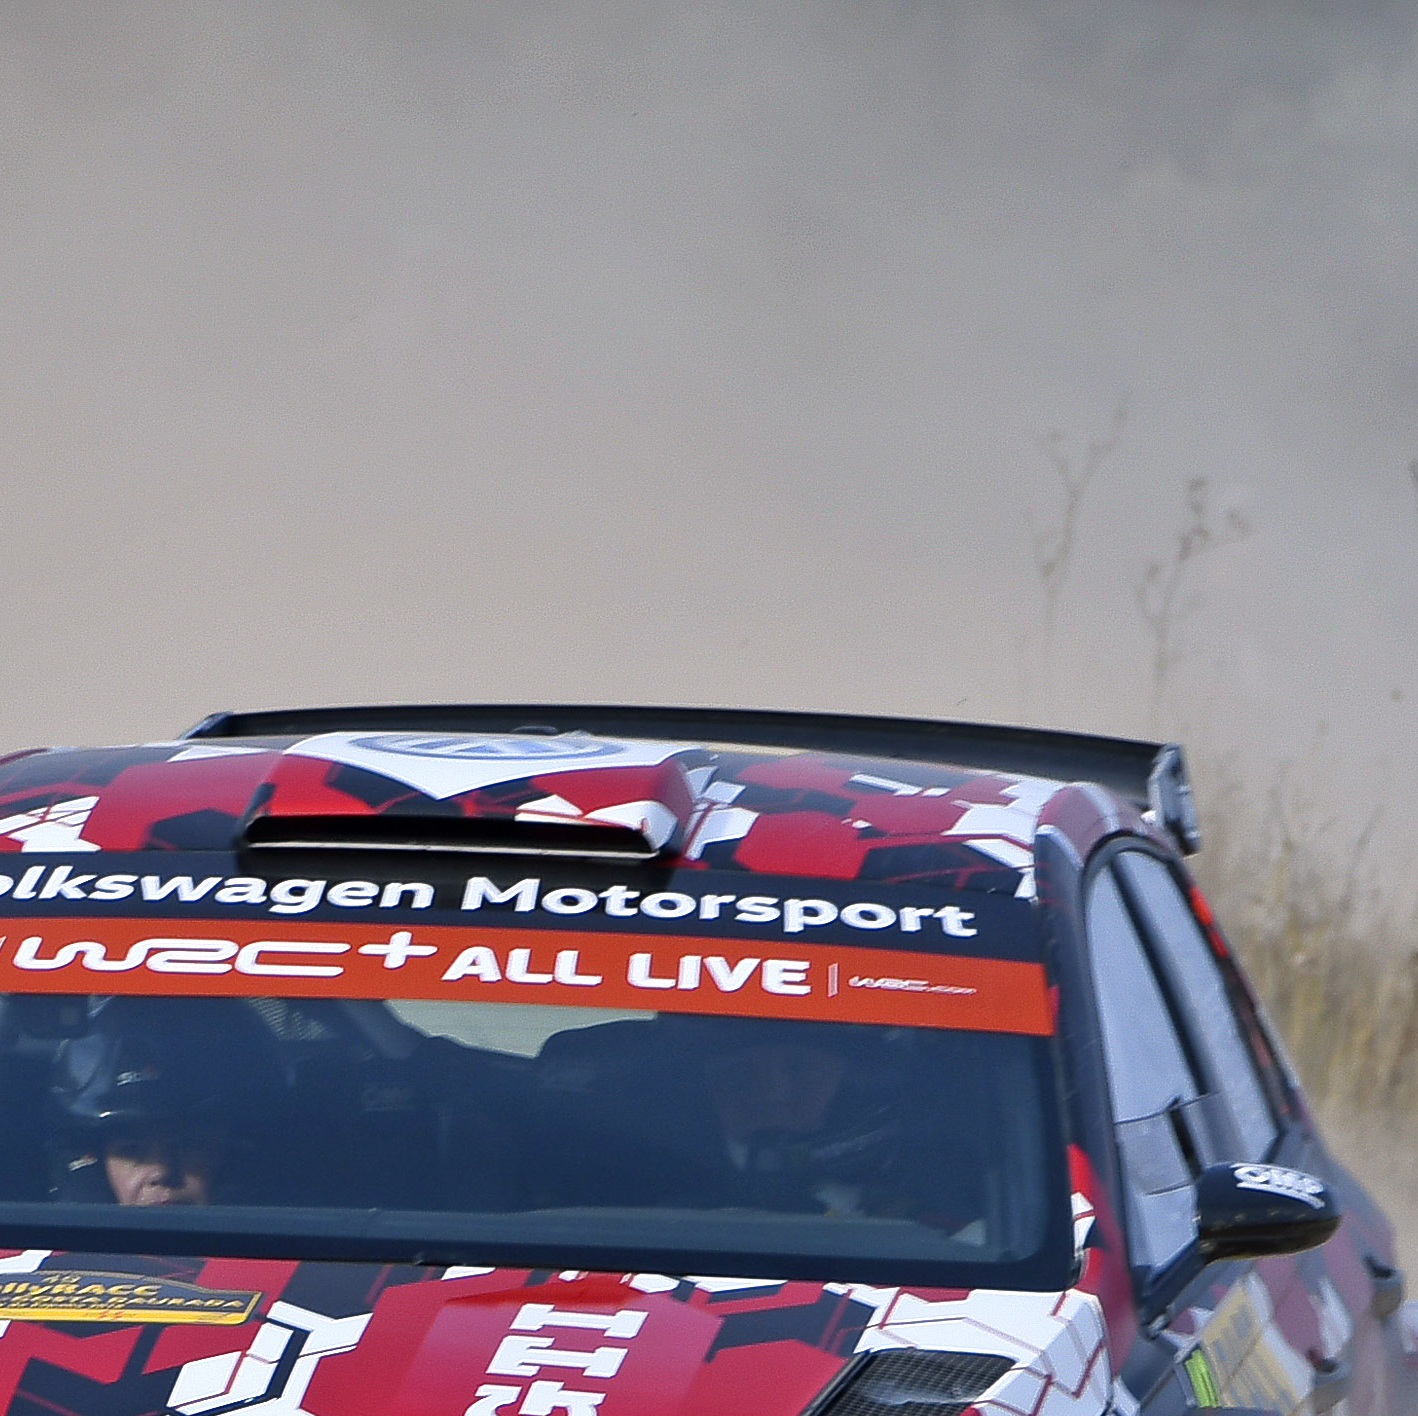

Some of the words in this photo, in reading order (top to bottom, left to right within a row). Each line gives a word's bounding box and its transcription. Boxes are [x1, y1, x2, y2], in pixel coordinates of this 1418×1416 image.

[460, 875, 977, 937] Motorsport
[442, 944, 603, 986] ALL
[626, 952, 813, 996] LIVE
